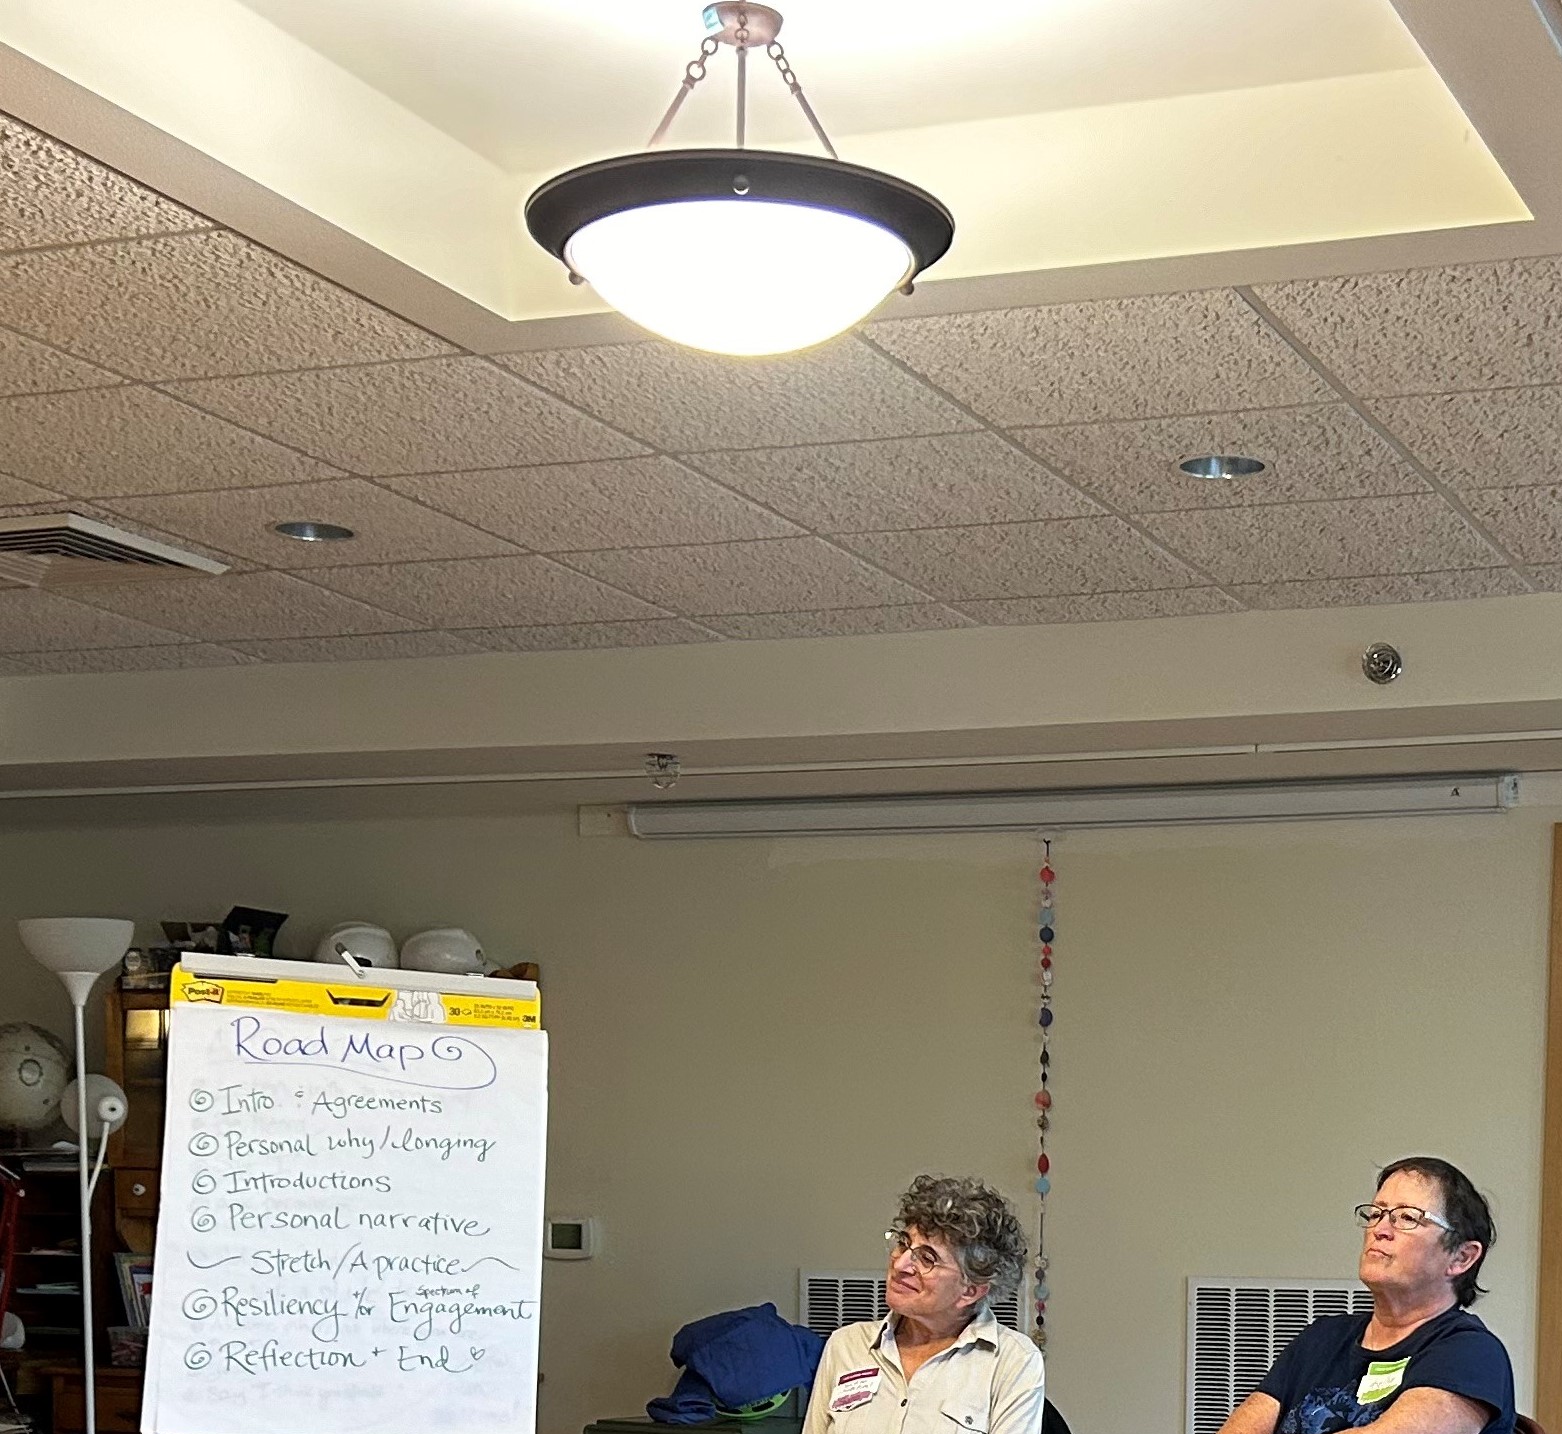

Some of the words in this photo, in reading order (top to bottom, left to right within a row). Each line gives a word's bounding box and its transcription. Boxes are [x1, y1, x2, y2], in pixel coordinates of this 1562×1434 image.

[449, 1007, 461, 1016] 30
[522, 1015, 536, 1023] 3M
[230, 1015, 329, 1062] Road
[341, 1033, 424, 1071] Map
[221, 1084, 275, 1116] Intro
[311, 1090, 443, 1119] Agreements
[224, 1129, 317, 1161] Personal
[223, 1169, 392, 1194] Introductions
[228, 1203, 350, 1230] Personal
[359, 1211, 491, 1238] narrative
[374, 1252, 462, 1279] practice
[221, 1286, 348, 1343] Resiliency
[389, 1291, 539, 1341] Engagement
[220, 1340, 367, 1376] Reflection
[398, 1345, 472, 1374] End
